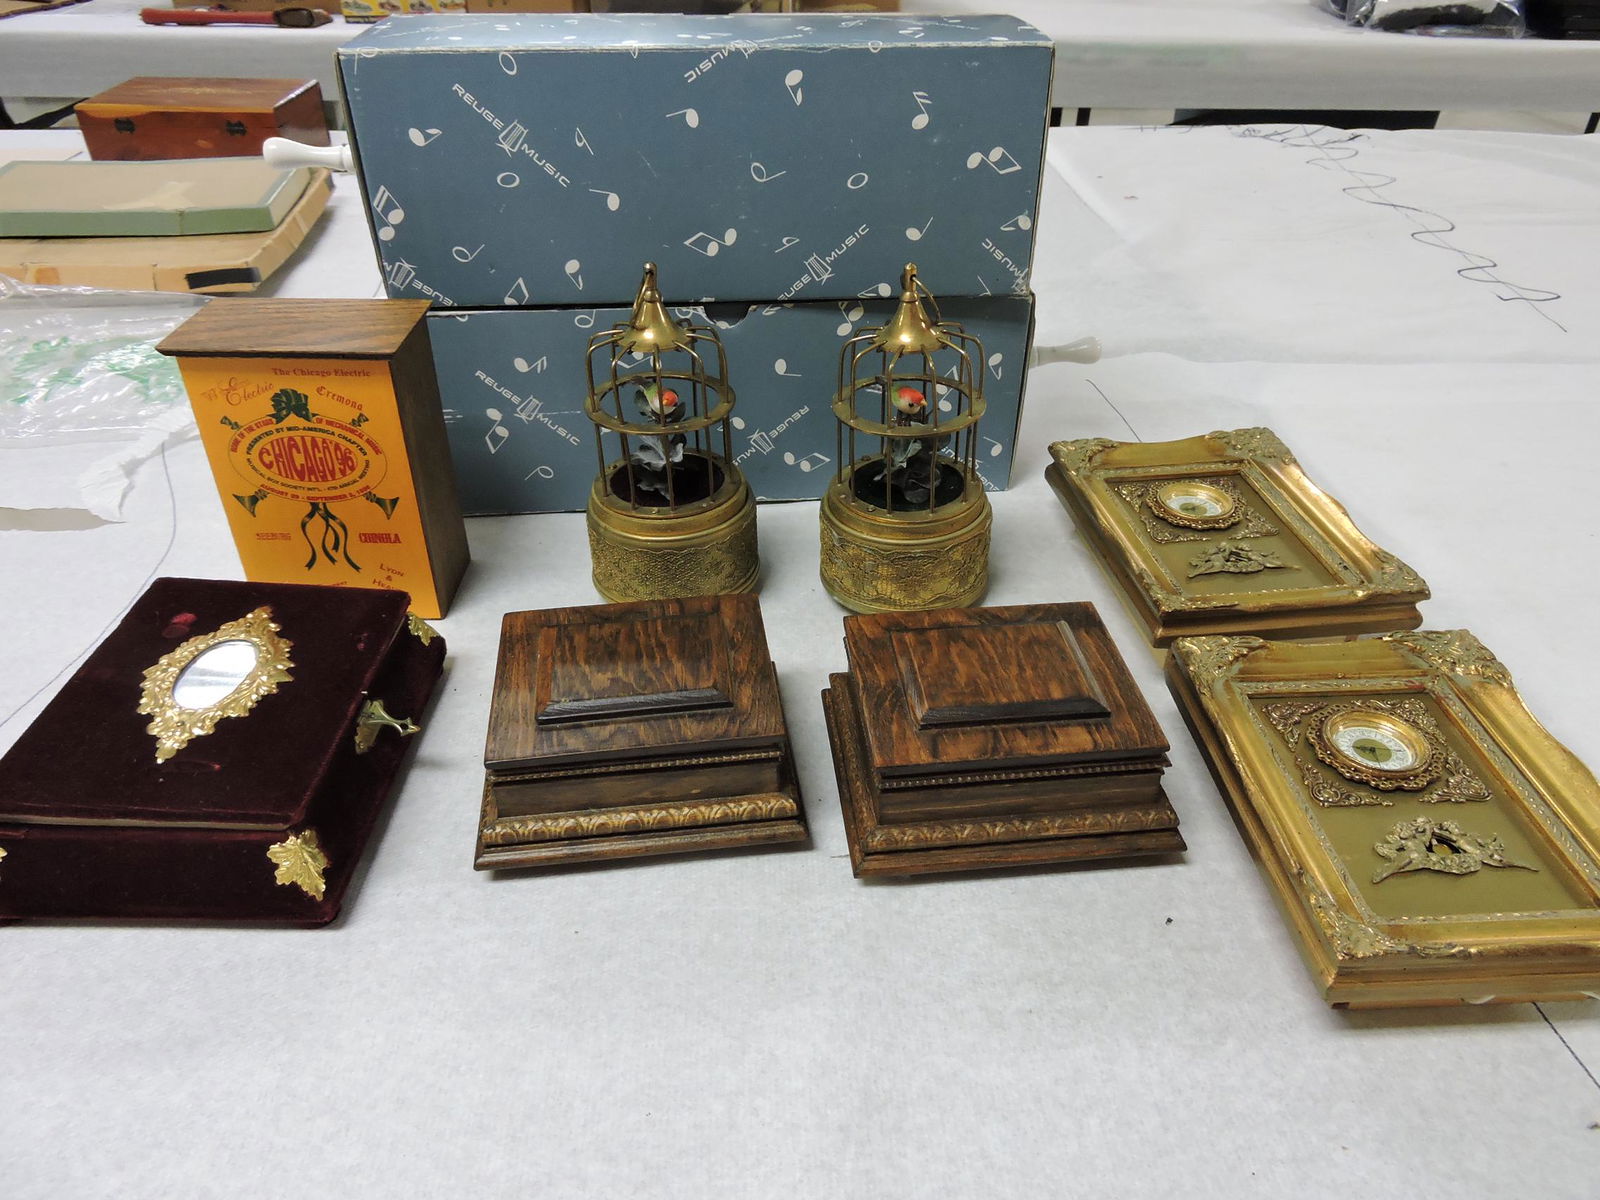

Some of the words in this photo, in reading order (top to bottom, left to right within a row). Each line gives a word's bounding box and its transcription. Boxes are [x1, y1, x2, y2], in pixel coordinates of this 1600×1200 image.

[683, 40, 737, 83] MUSIC
[451, 82, 505, 130] REUGE
[521, 143, 571, 188] MUSIC
[776, 273, 812, 301] EUGE
[825, 223, 870, 264] MUSIC
[981, 237, 1023, 277] MUSIC
[411, 278, 458, 307] EUGE
[272, 367, 290, 376] The
[293, 368, 331, 378] Chicago
[333, 368, 371, 377] Electric
[316, 385, 363, 411] Cremona
[474, 369, 521, 405] REUGE
[536, 413, 581, 447] MUSIC
[768, 404, 811, 439] REUGE
[337, 433, 368, 457] CHAPTER
